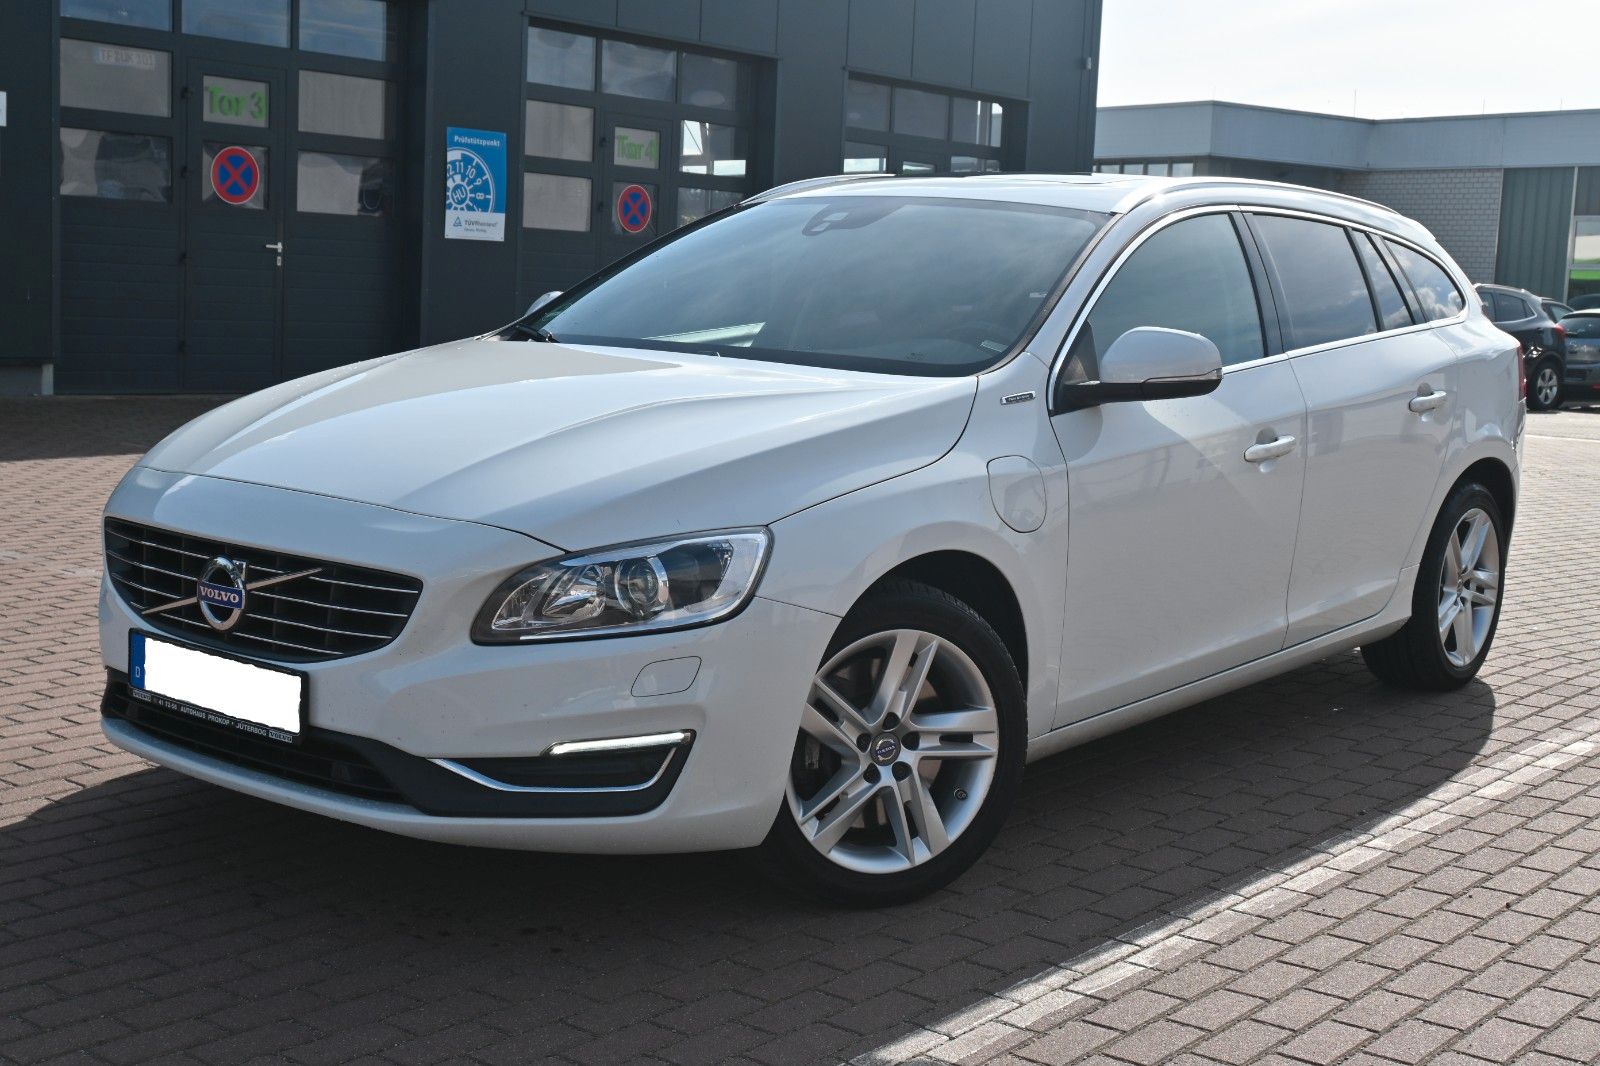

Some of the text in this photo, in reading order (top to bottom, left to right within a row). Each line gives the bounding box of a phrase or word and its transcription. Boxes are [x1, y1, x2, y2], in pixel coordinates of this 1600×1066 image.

[207, 86, 266, 120] Tor 3
[454, 135, 501, 147] Prüfstützpunkt
[456, 161, 465, 173] 11
[466, 165, 476, 179] 10
[473, 178, 482, 186] 9
[452, 186, 467, 203] HU
[199, 585, 240, 604] VOLVO
[135, 665, 141, 678] D
[180, 706, 206, 719] AUTOHAUS
[207, 714, 230, 726] PROKOP
[235, 721, 267, 736] JÜTERBOG
